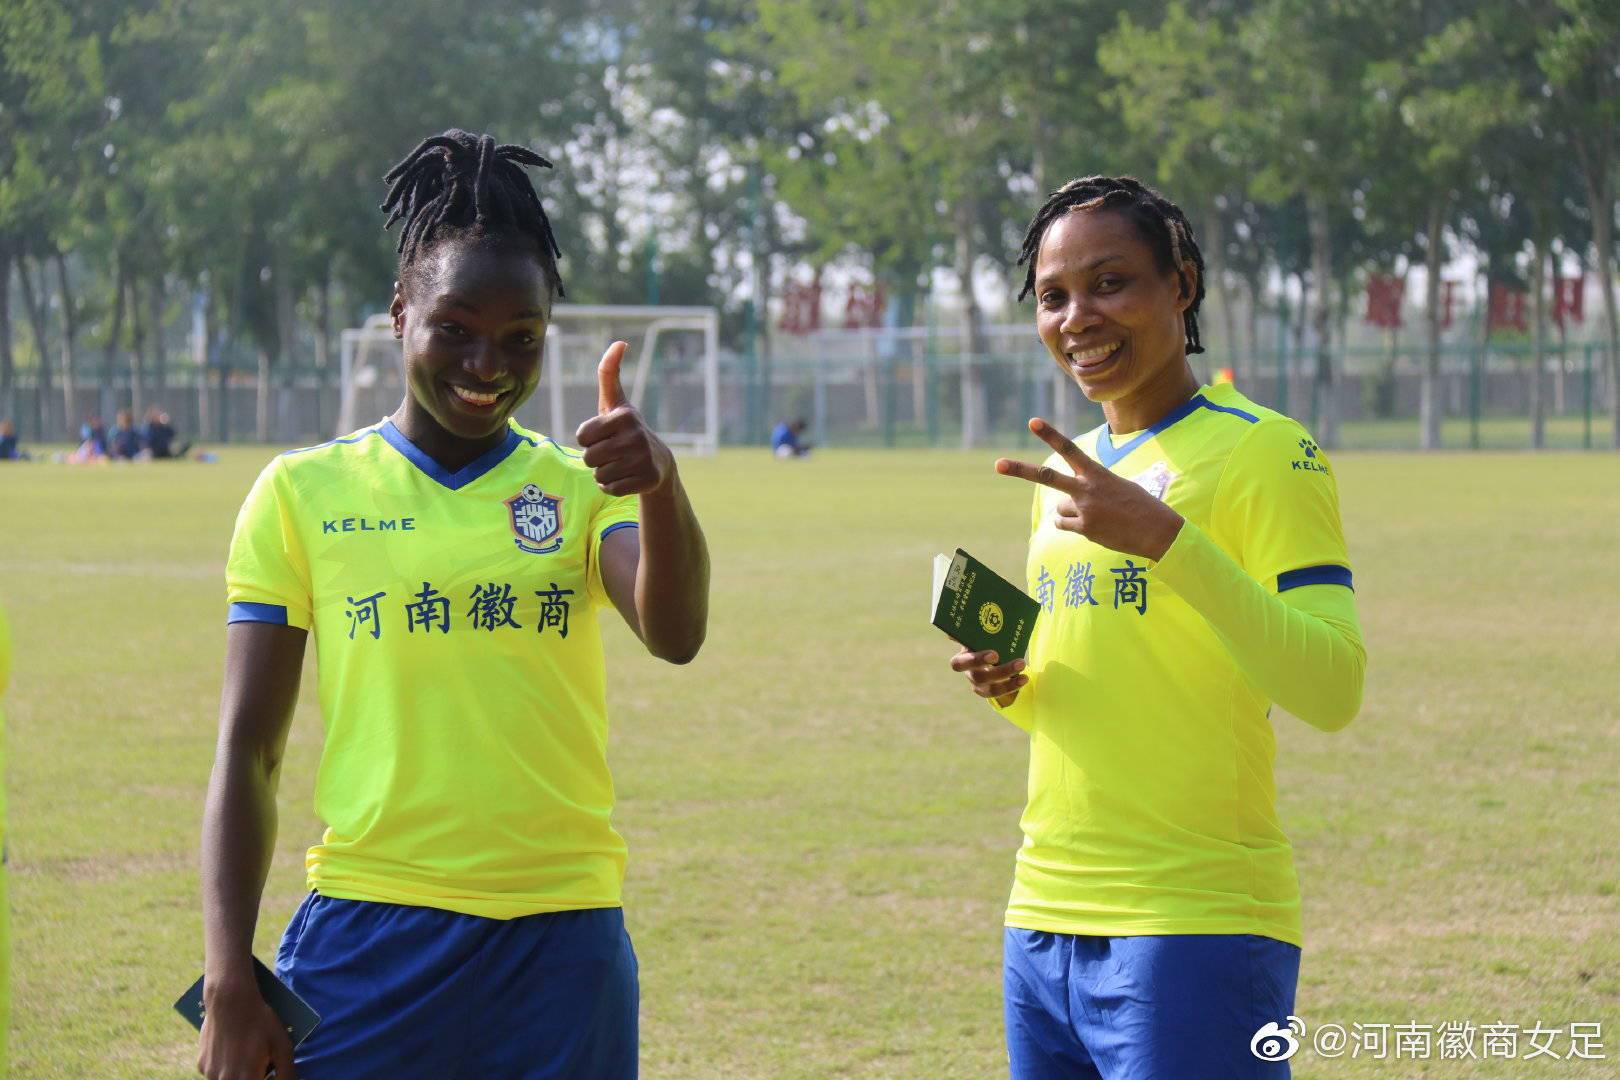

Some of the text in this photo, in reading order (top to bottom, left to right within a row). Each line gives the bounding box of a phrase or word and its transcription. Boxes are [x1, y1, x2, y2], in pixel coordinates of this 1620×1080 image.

[322, 517, 416, 534] KELME
[345, 581, 575, 641] 河南徽商
